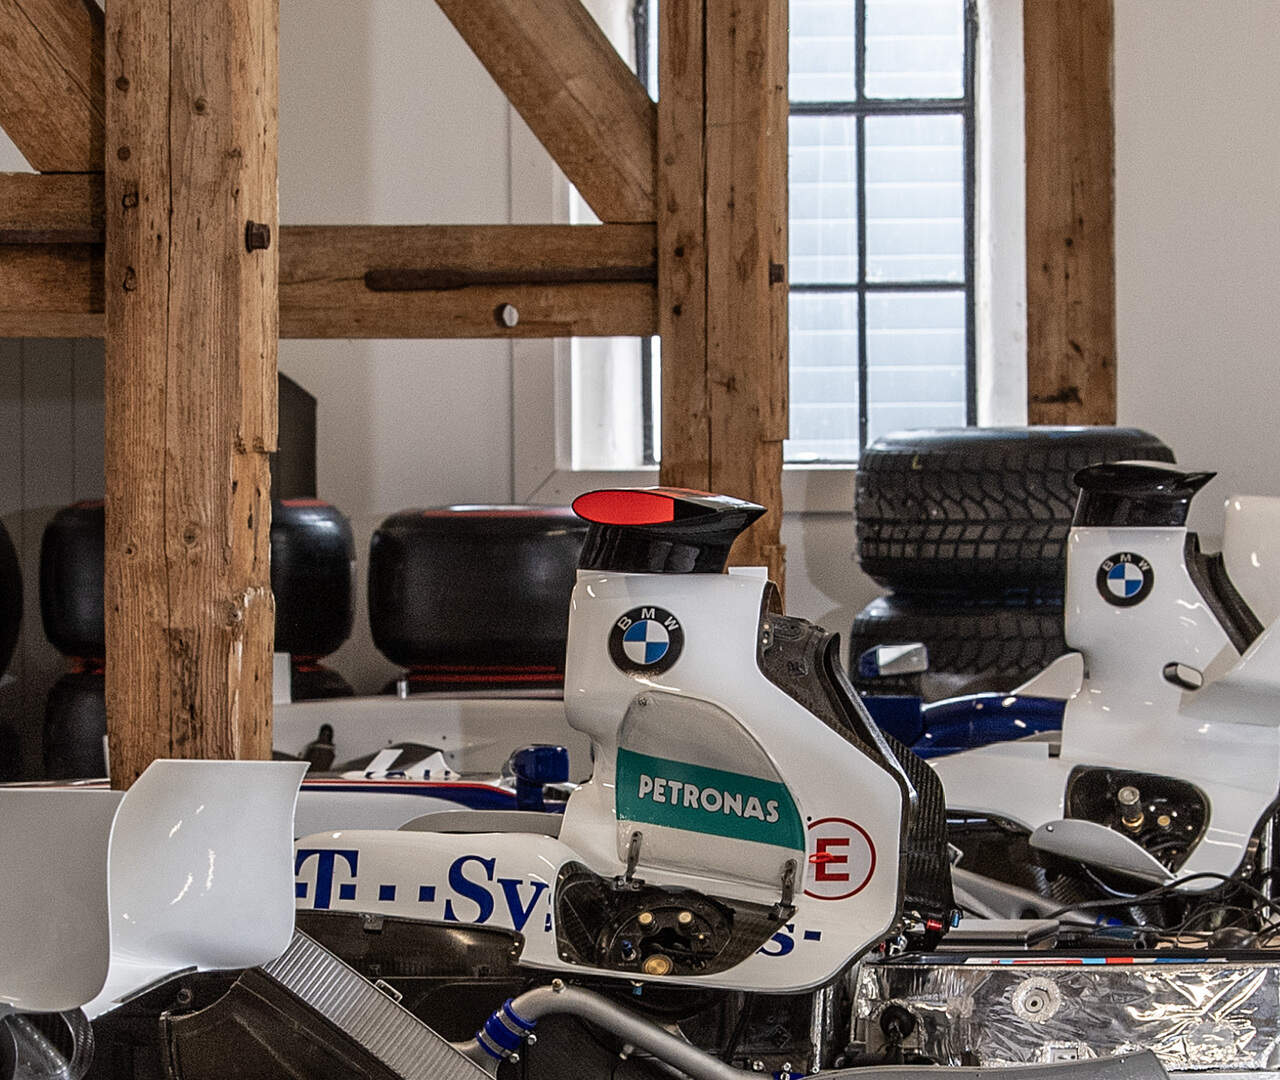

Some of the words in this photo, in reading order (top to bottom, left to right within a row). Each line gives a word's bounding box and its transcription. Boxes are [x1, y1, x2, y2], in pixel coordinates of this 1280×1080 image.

[1102, 553, 1150, 571] BMW
[617, 608, 679, 631] BMW
[638, 773, 780, 824] PETRONAS
[815, 838, 850, 881] E
